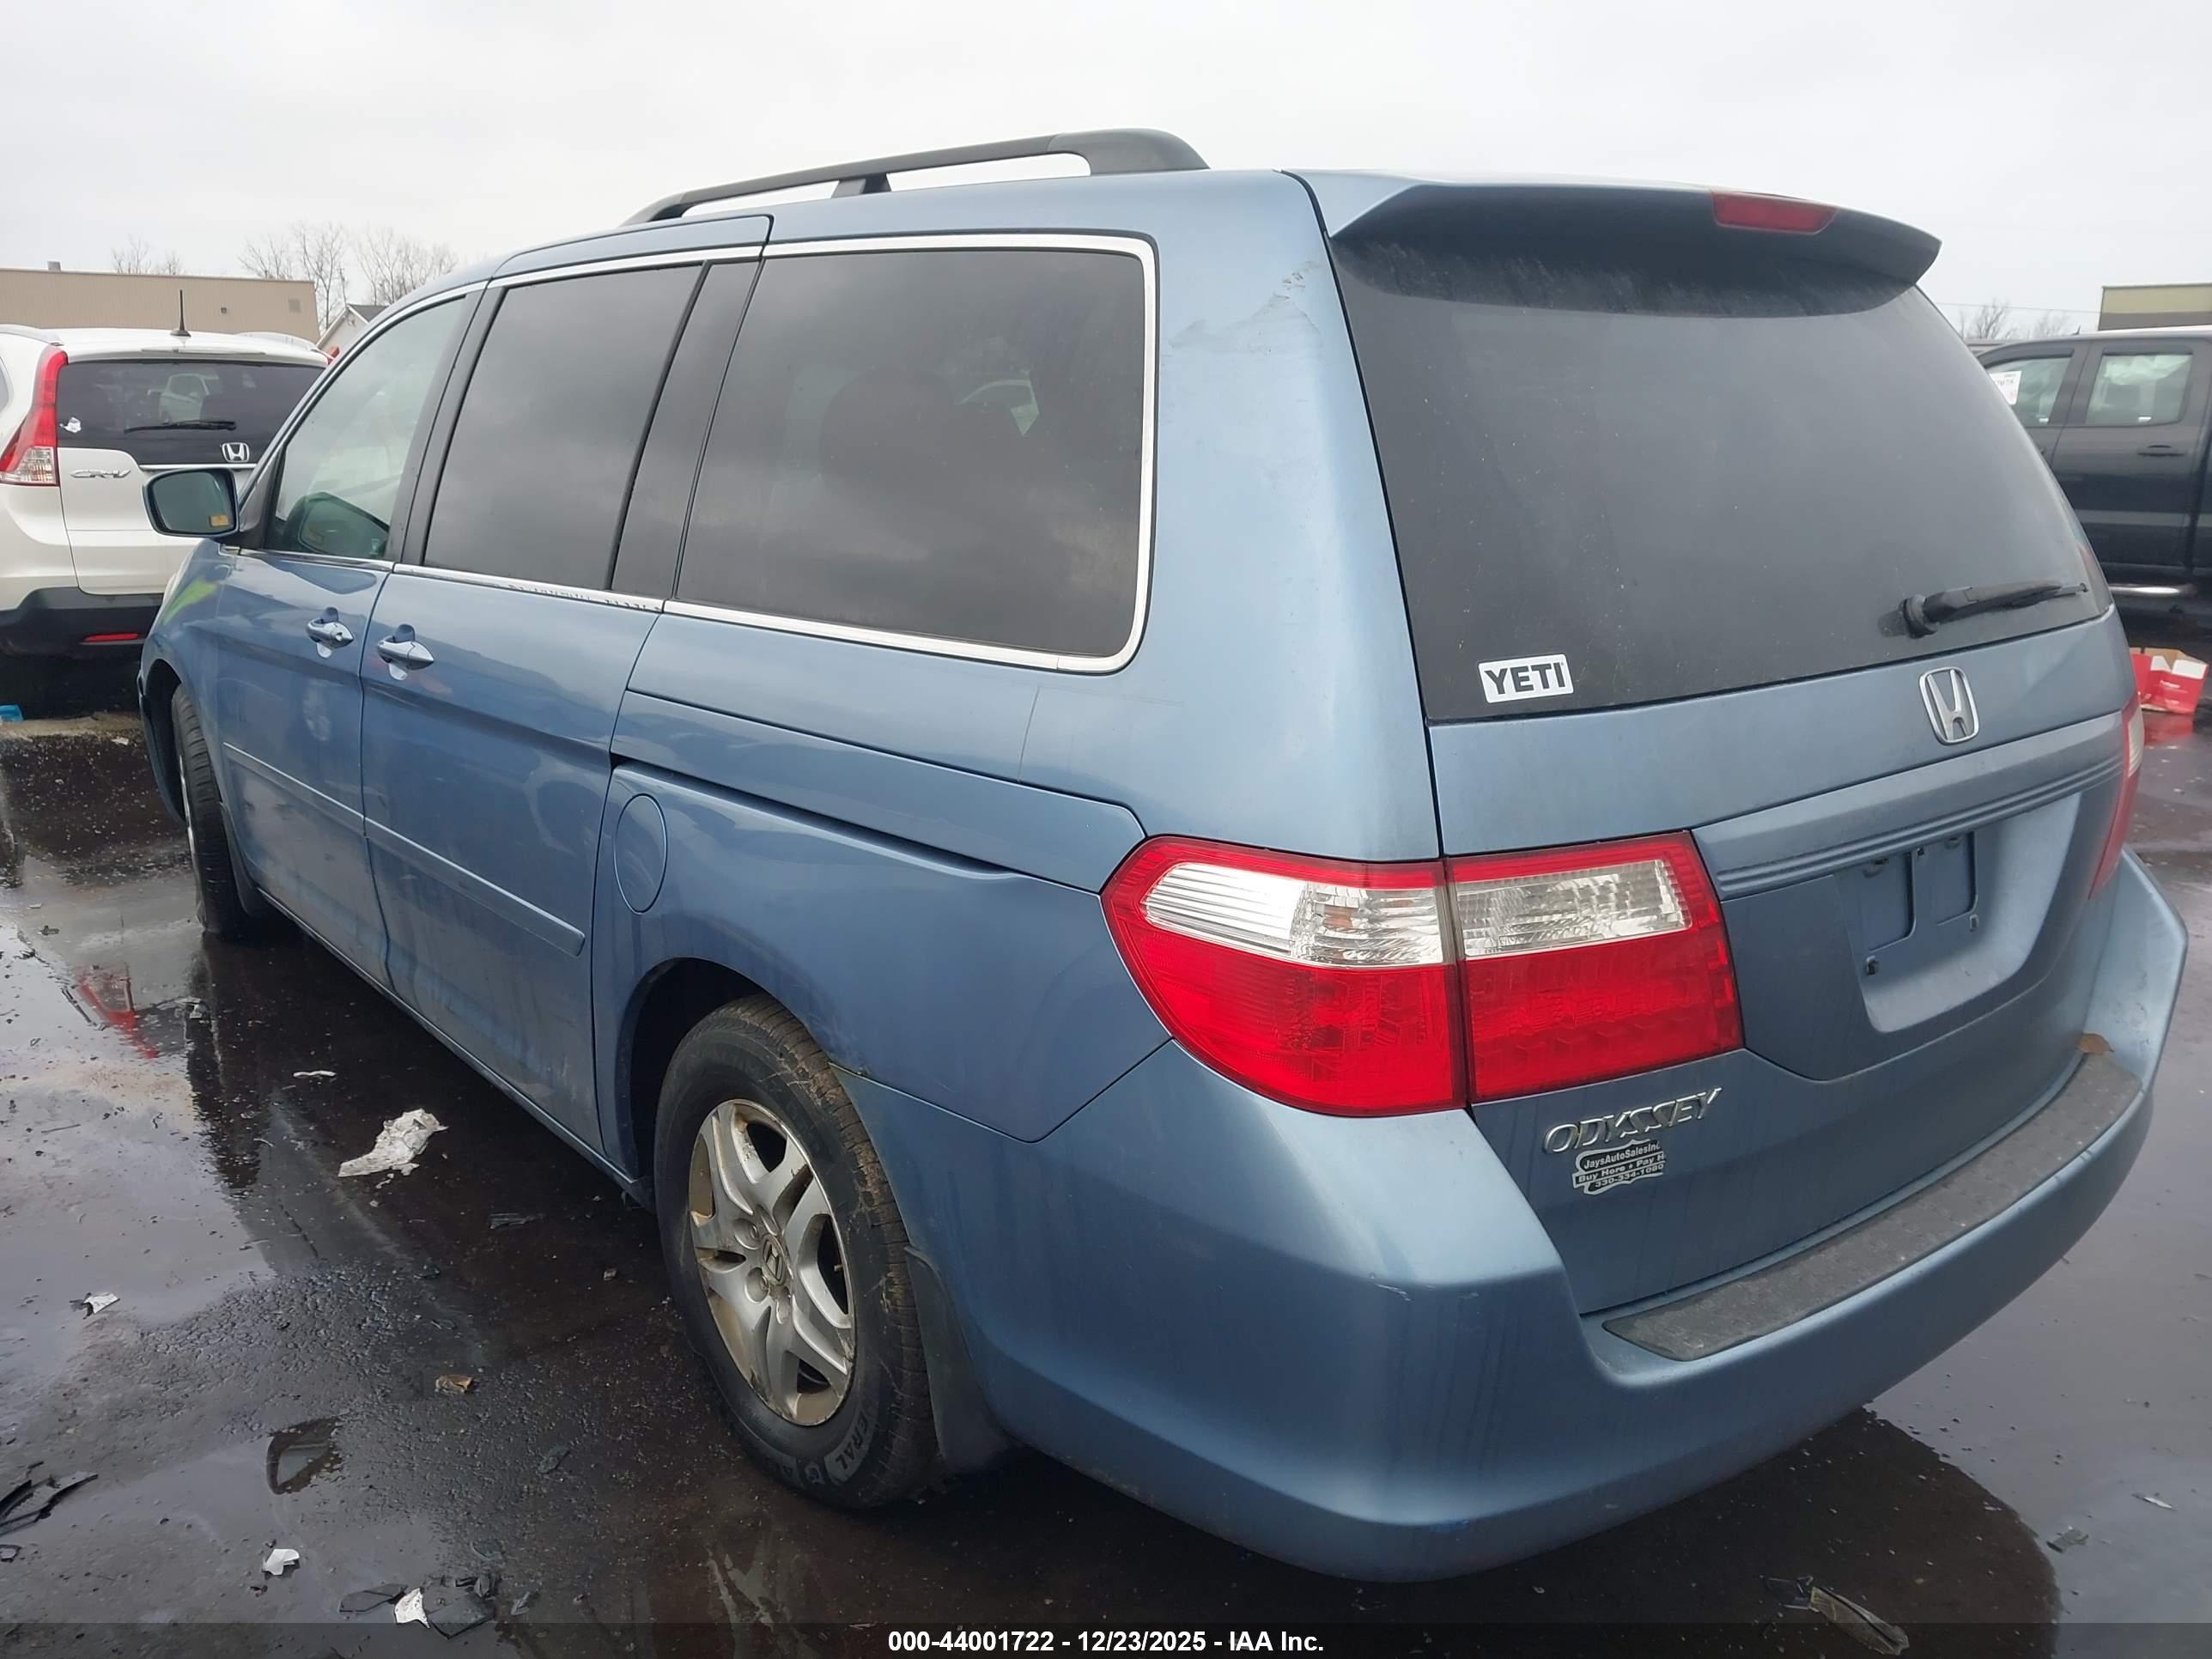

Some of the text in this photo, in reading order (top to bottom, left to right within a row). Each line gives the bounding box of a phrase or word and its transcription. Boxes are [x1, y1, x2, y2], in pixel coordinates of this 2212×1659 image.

[1484, 662, 1566, 695] YETI
[1543, 1087, 1722, 1153] ODYSSEY
[1578, 1172, 1599, 1183] Buy
[1636, 1157, 1656, 1168] Pay
